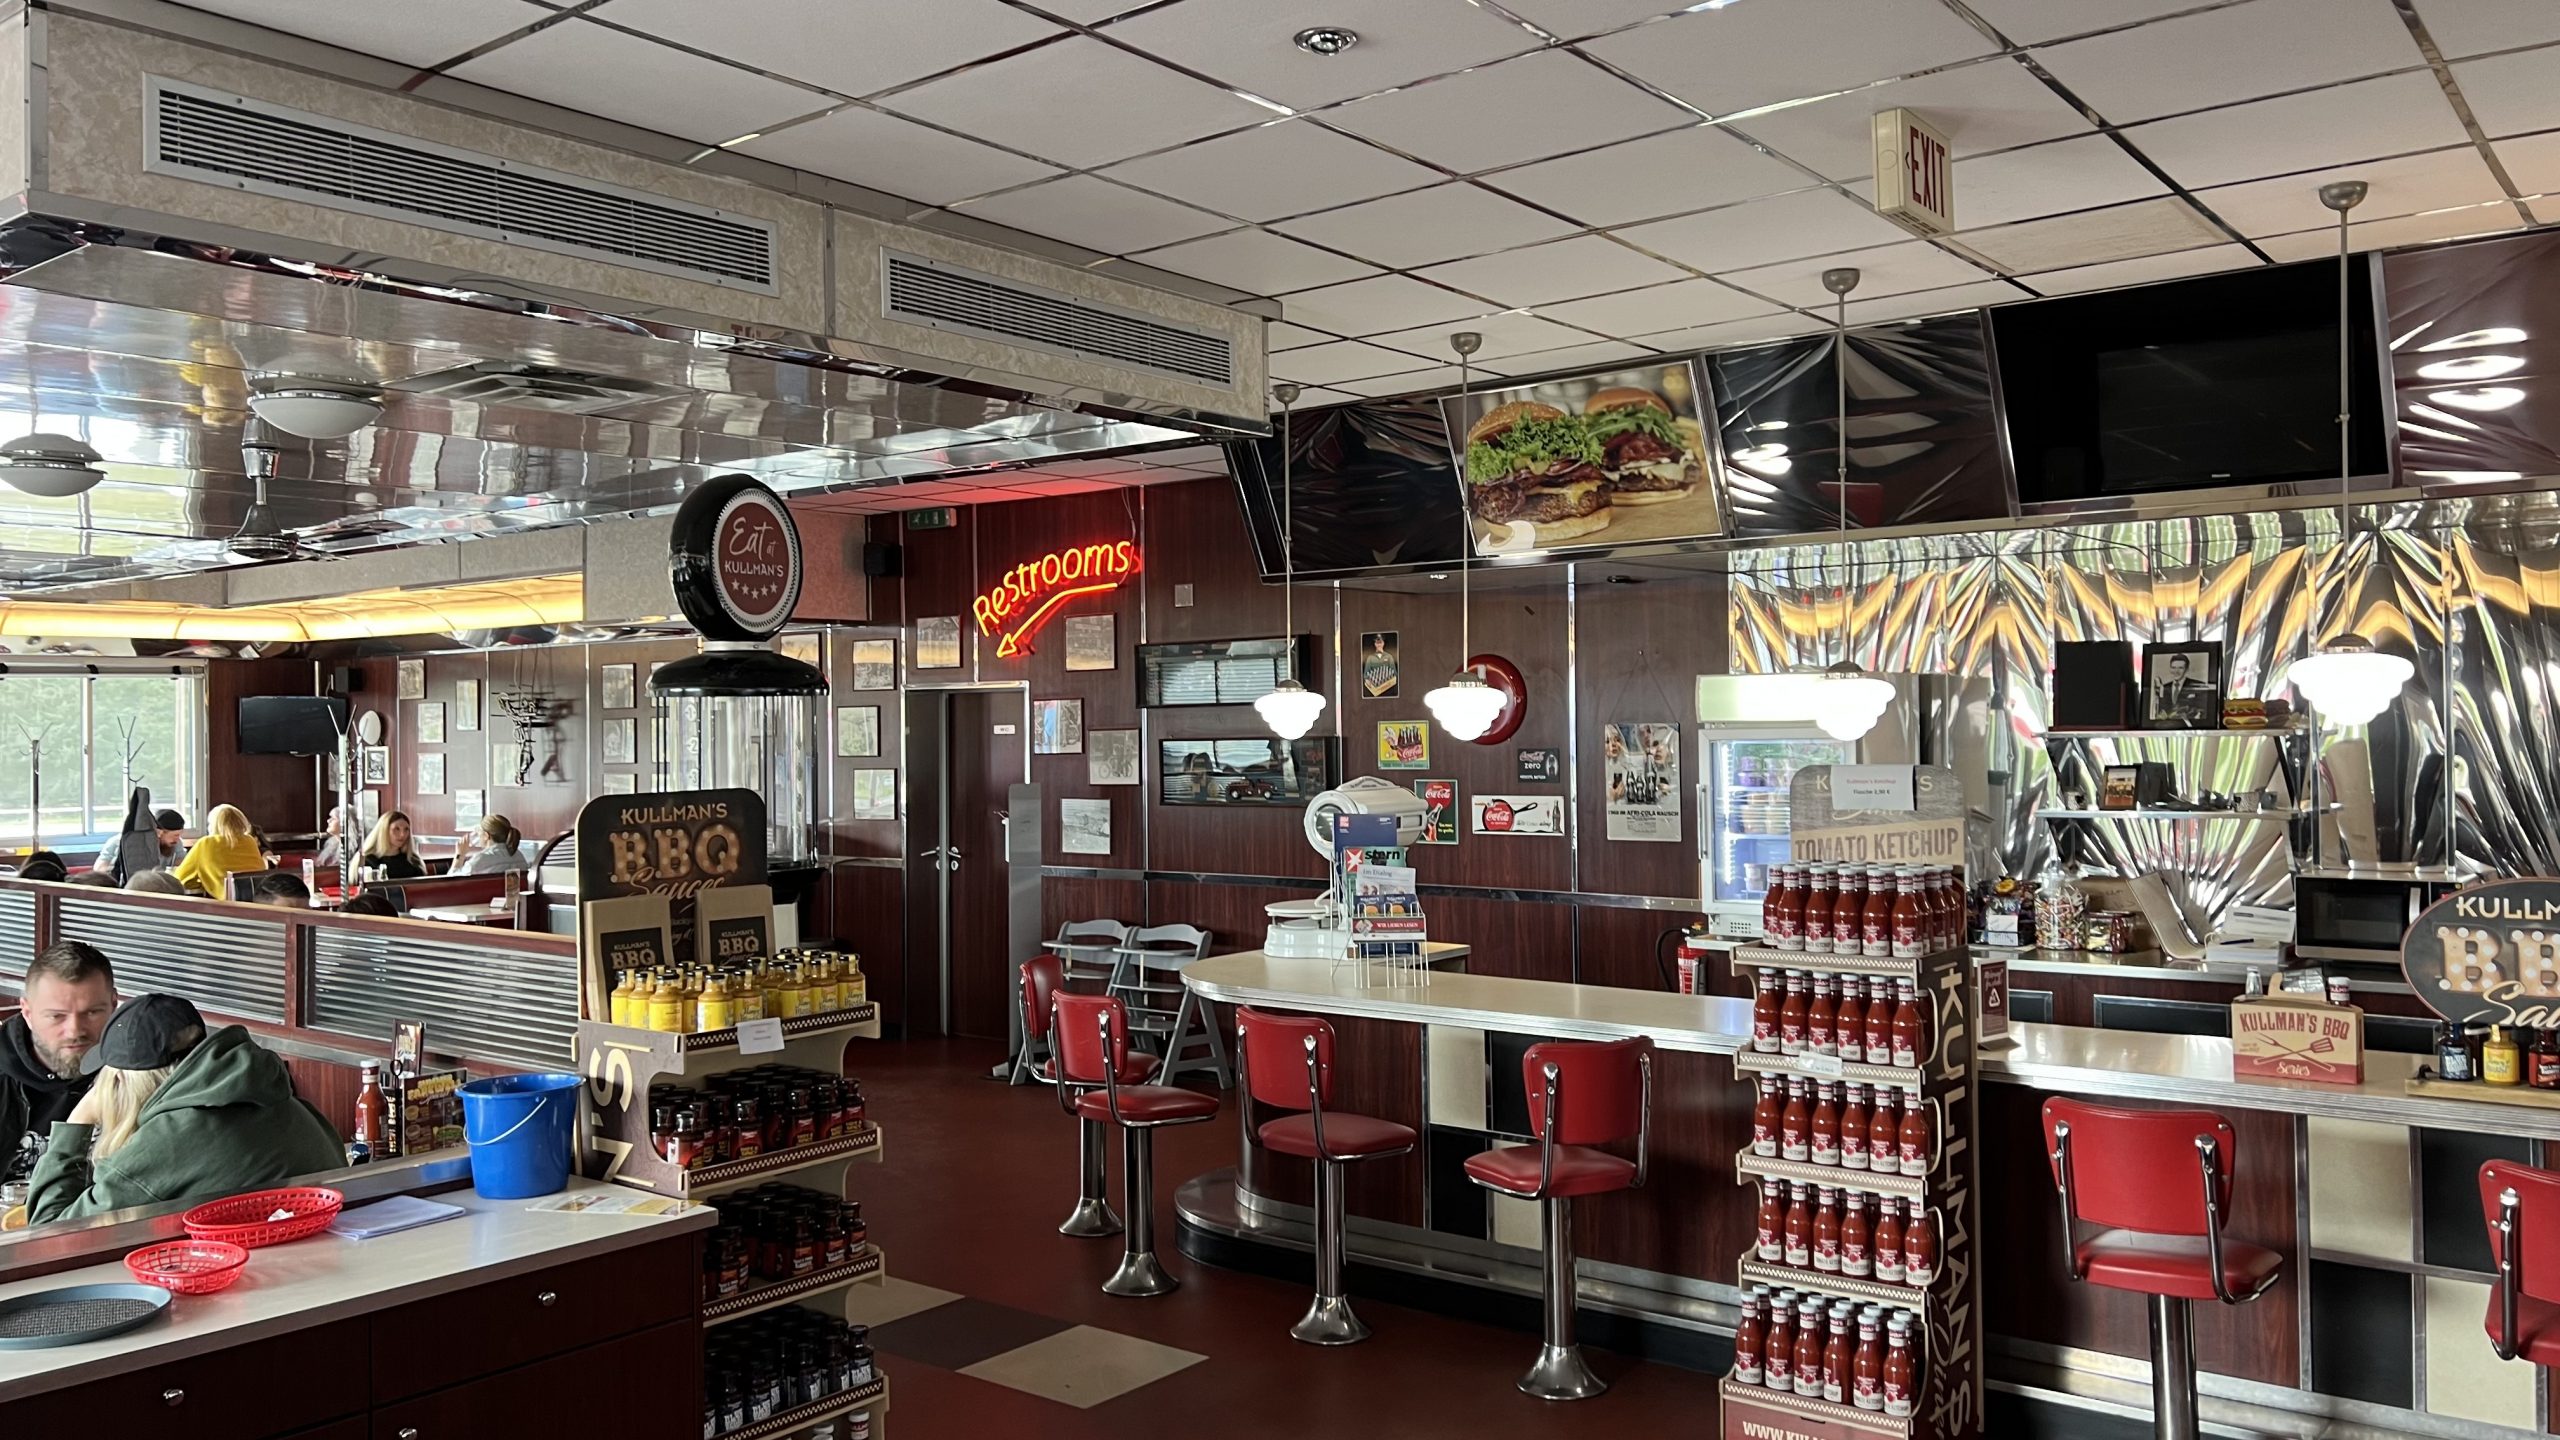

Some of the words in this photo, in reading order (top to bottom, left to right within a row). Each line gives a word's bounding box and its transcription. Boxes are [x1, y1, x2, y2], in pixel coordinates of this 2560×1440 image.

[1910, 125, 1945, 218] EXIT
[729, 516, 774, 560] Eat
[766, 540, 779, 557] at
[724, 560, 784, 577] KULLMAN'S
[973, 541, 1130, 637] Restrooms
[1425, 788, 1451, 799] Coca-Cola
[621, 803, 728, 825] KULLMAN'S
[1485, 809, 1510, 822] Coca-Cola
[609, 824, 741, 883] BBQ
[1365, 850, 1400, 860] stern
[1795, 835, 1868, 862] TOMATO
[1874, 828, 1959, 860] KETCHUP
[1372, 869, 1392, 878] Dialog
[721, 929, 755, 938] KULLMAN'S
[614, 941, 650, 950] KULLMAN'S
[718, 936, 760, 956] BBQ
[610, 949, 656, 970] BBQ
[2240, 1012, 2318, 1034] KULLMAN'S
[2322, 1017, 2350, 1040] BBQ
[2276, 1061, 2310, 1077] Series
[1940, 968, 1971, 1437] KULLMAN'S
